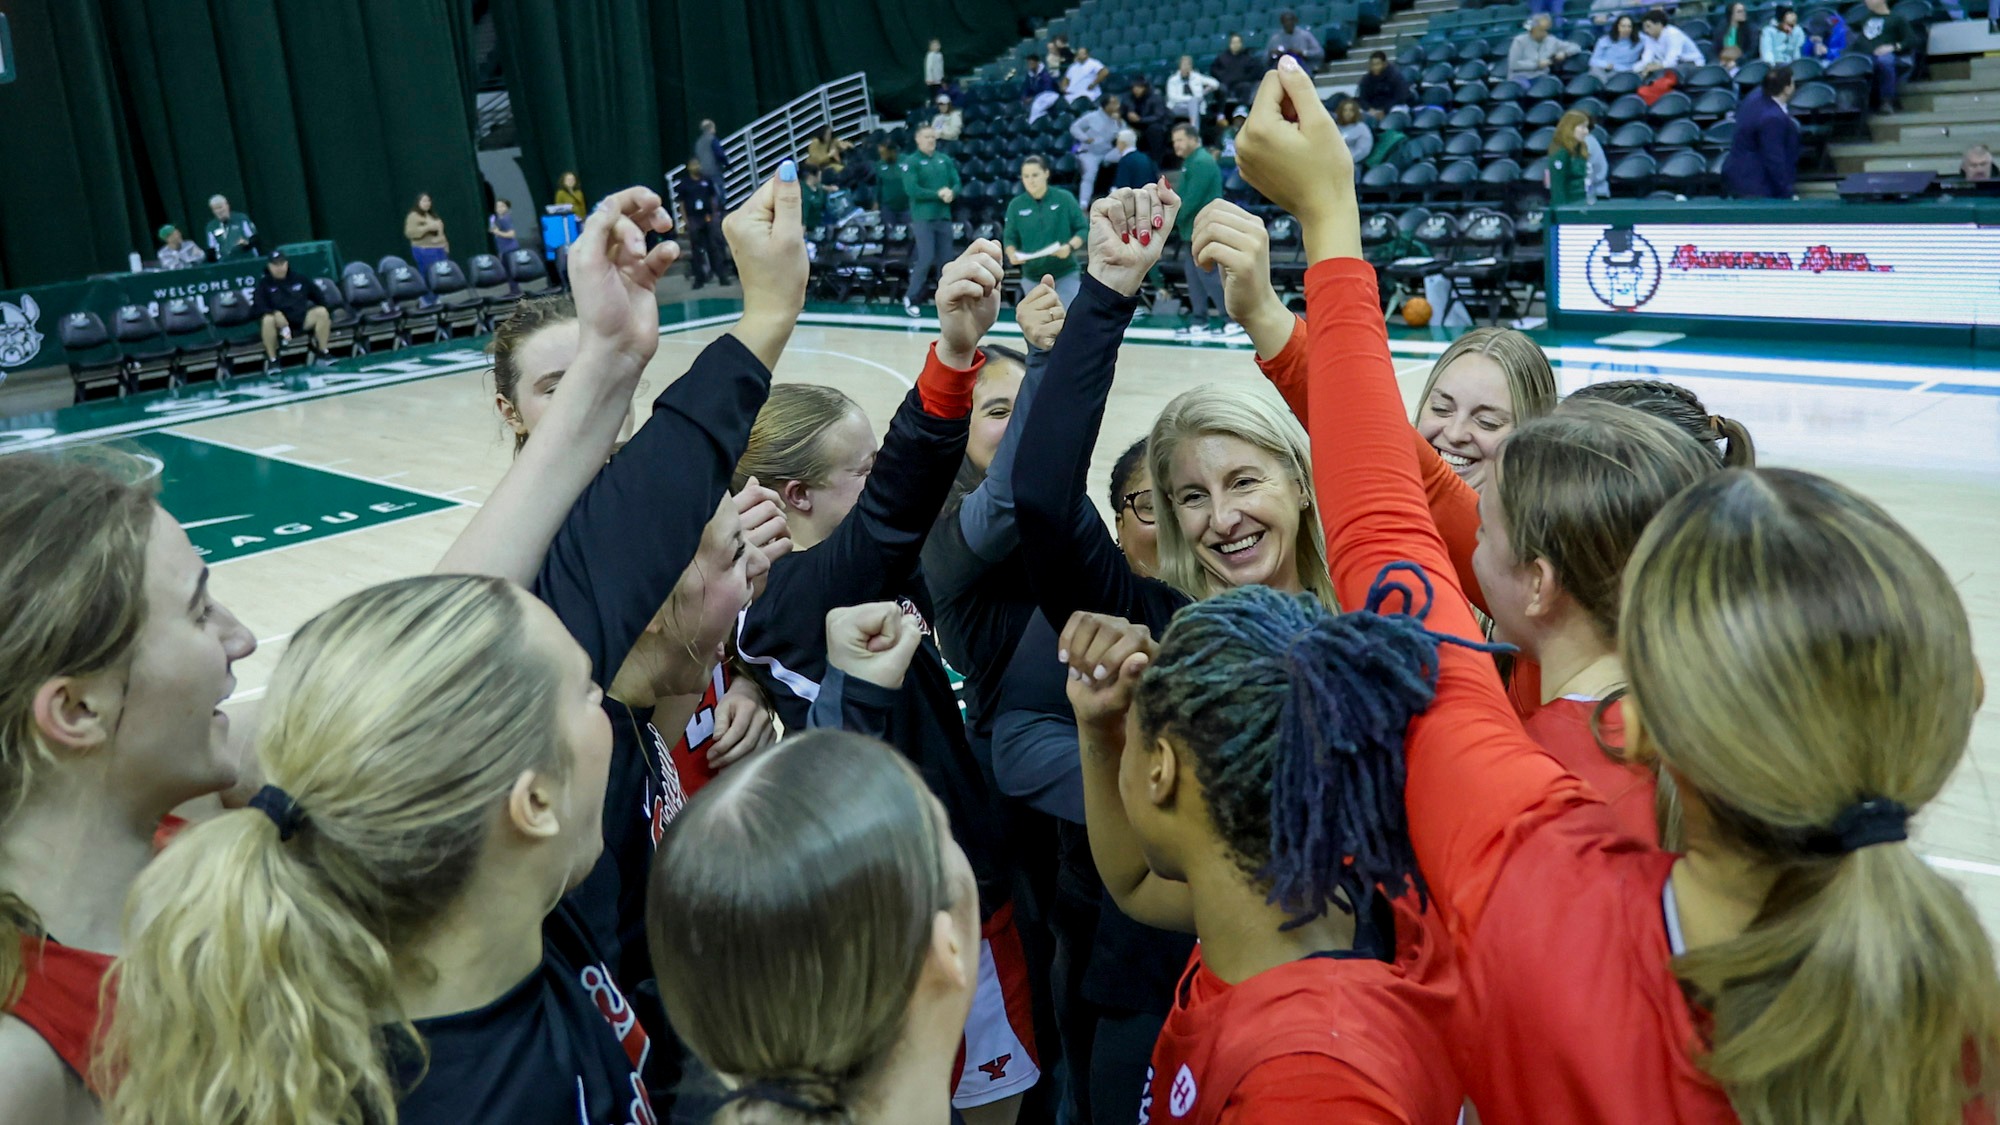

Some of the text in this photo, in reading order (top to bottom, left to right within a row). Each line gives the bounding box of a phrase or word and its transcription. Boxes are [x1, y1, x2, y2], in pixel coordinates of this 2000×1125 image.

[153, 275, 256, 299] WELCOME TO
[978, 1052, 1012, 1081] Y
